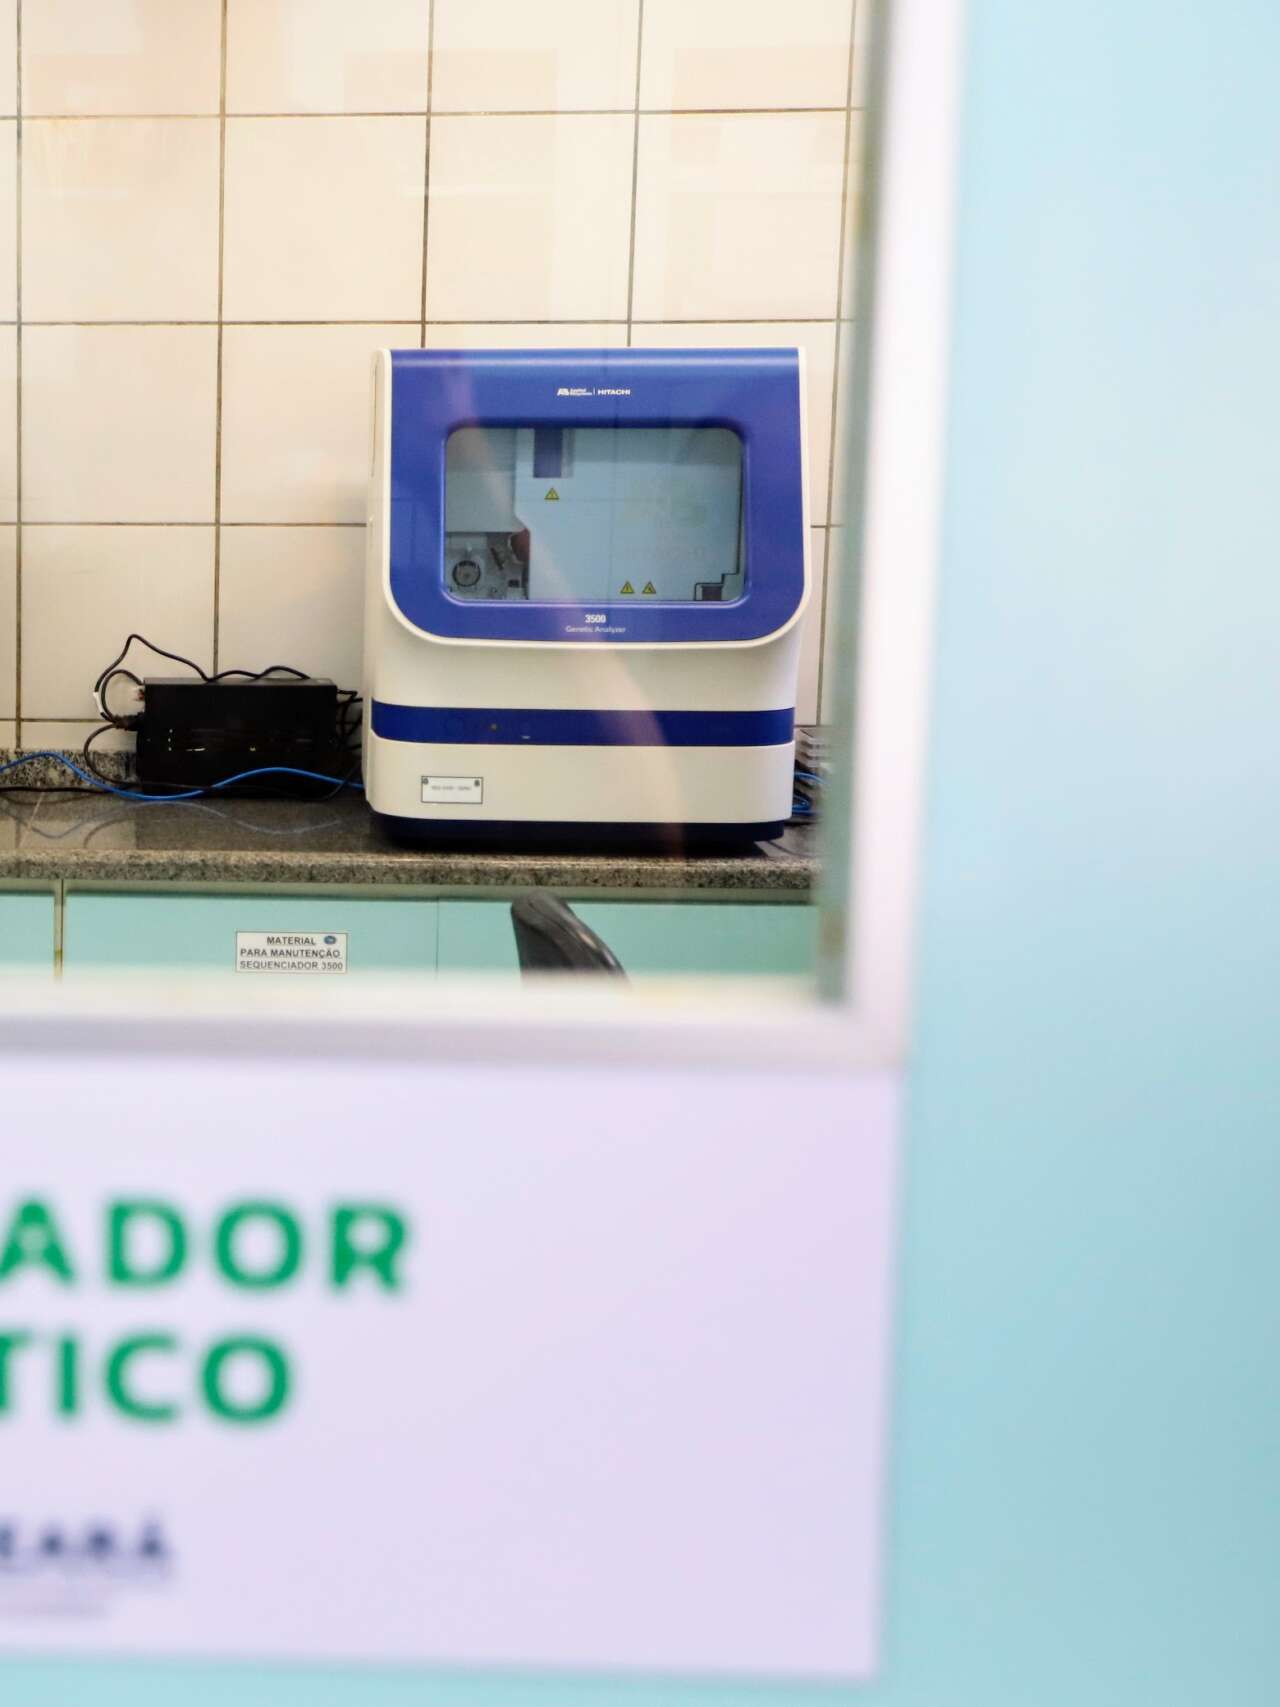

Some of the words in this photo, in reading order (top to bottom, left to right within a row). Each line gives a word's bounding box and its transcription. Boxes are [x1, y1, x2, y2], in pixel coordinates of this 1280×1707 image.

[598, 388, 631, 396] HITACHI
[585, 614, 606, 623] 3500
[267, 936, 316, 945] MATERIAL
[240, 948, 267, 957] PARA
[271, 948, 341, 959] MANUTENÇÃO
[239, 960, 319, 971] SEQUENCIADOR
[321, 961, 344, 971] 3500
